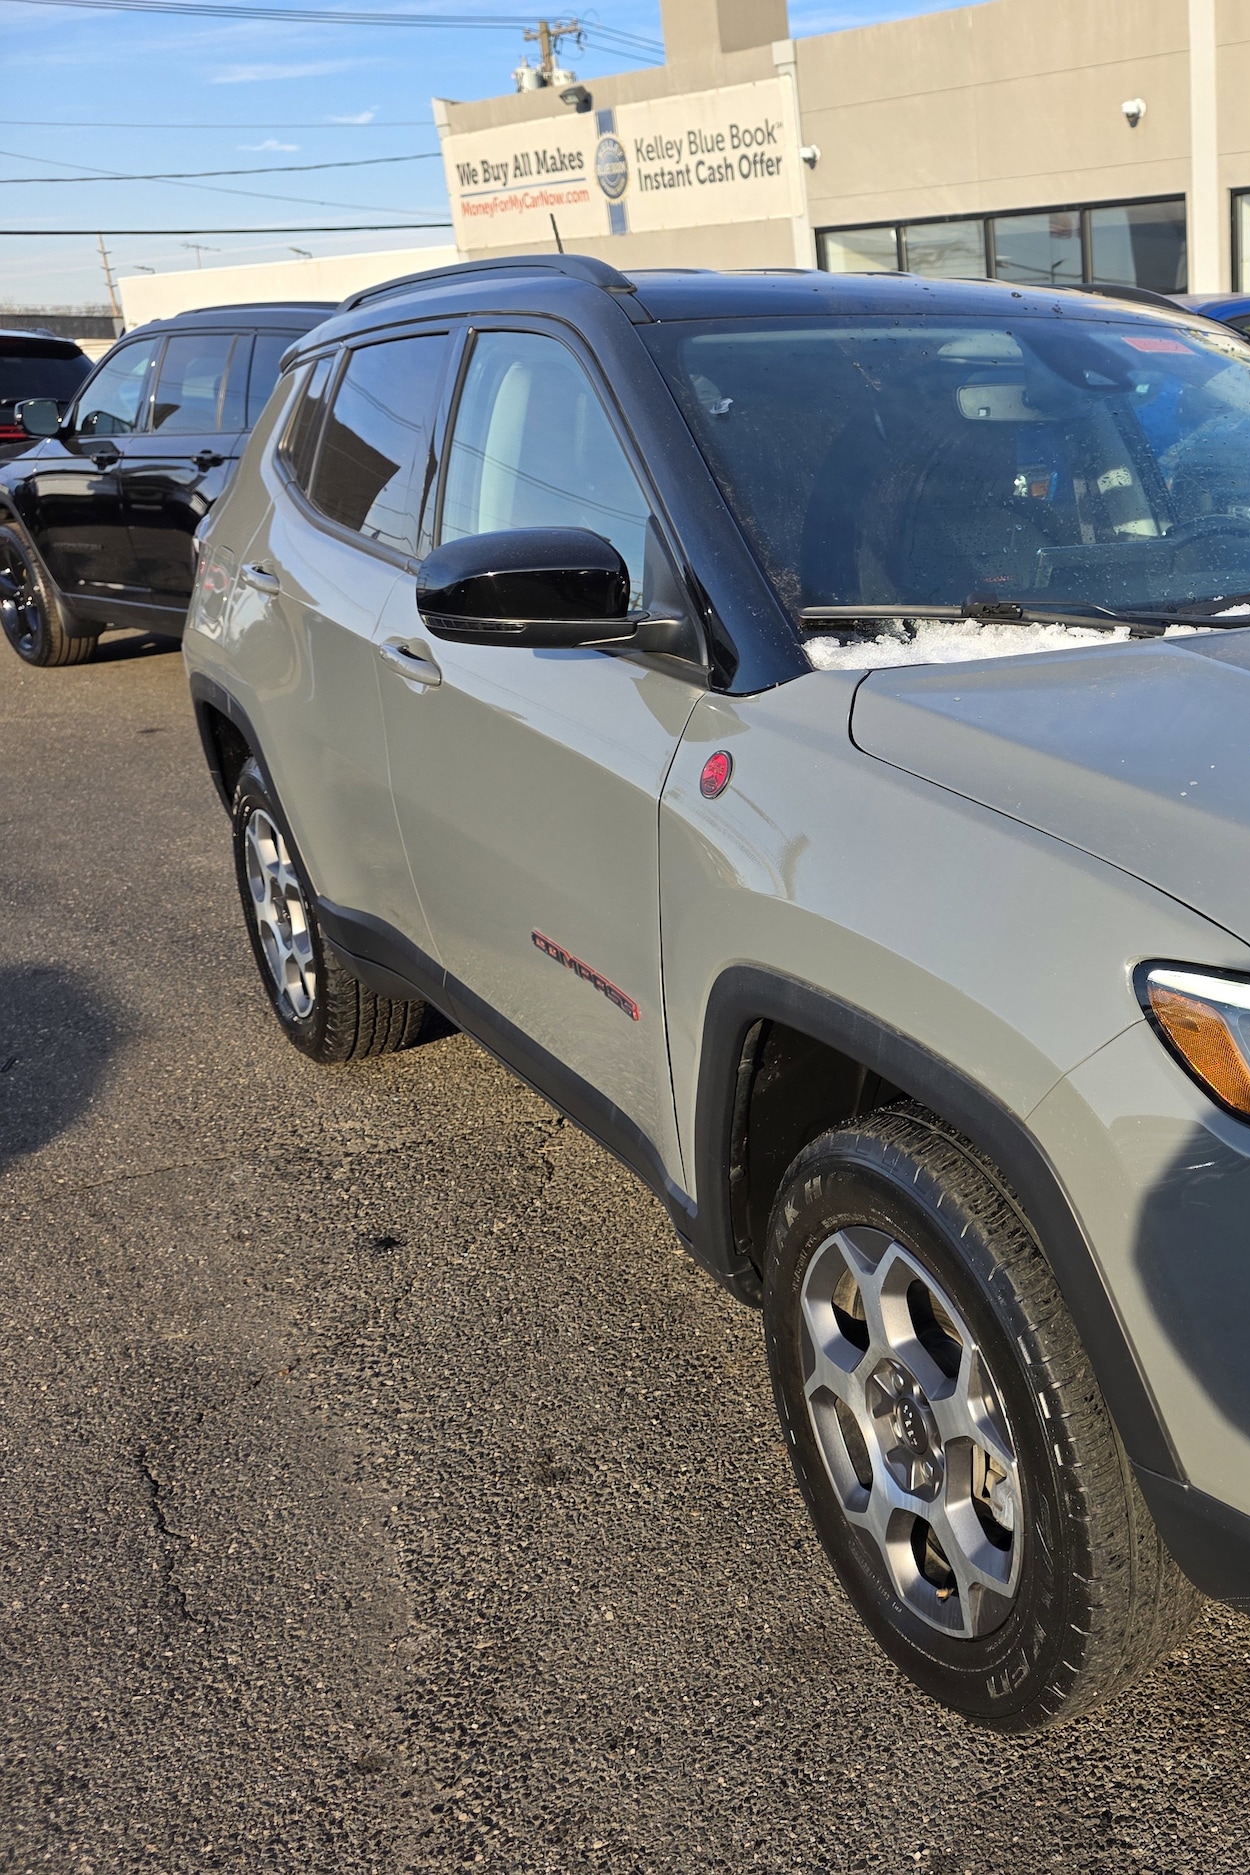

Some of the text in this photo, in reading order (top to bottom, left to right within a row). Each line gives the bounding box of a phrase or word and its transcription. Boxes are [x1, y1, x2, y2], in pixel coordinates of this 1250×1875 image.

[634, 136, 683, 164] Kelley
[687, 128, 726, 155] Blue
[729, 118, 777, 149] Book
[457, 162, 479, 187] We
[480, 158, 509, 187] Buy
[513, 151, 533, 179] All
[535, 147, 584, 175] Makes
[637, 163, 693, 192] Instant
[695, 155, 735, 185] Cash
[738, 151, 783, 179] Offer
[461, 189, 591, 219] MoneyForMyCarNow.com
[531, 928, 639, 1021] COMPASS
